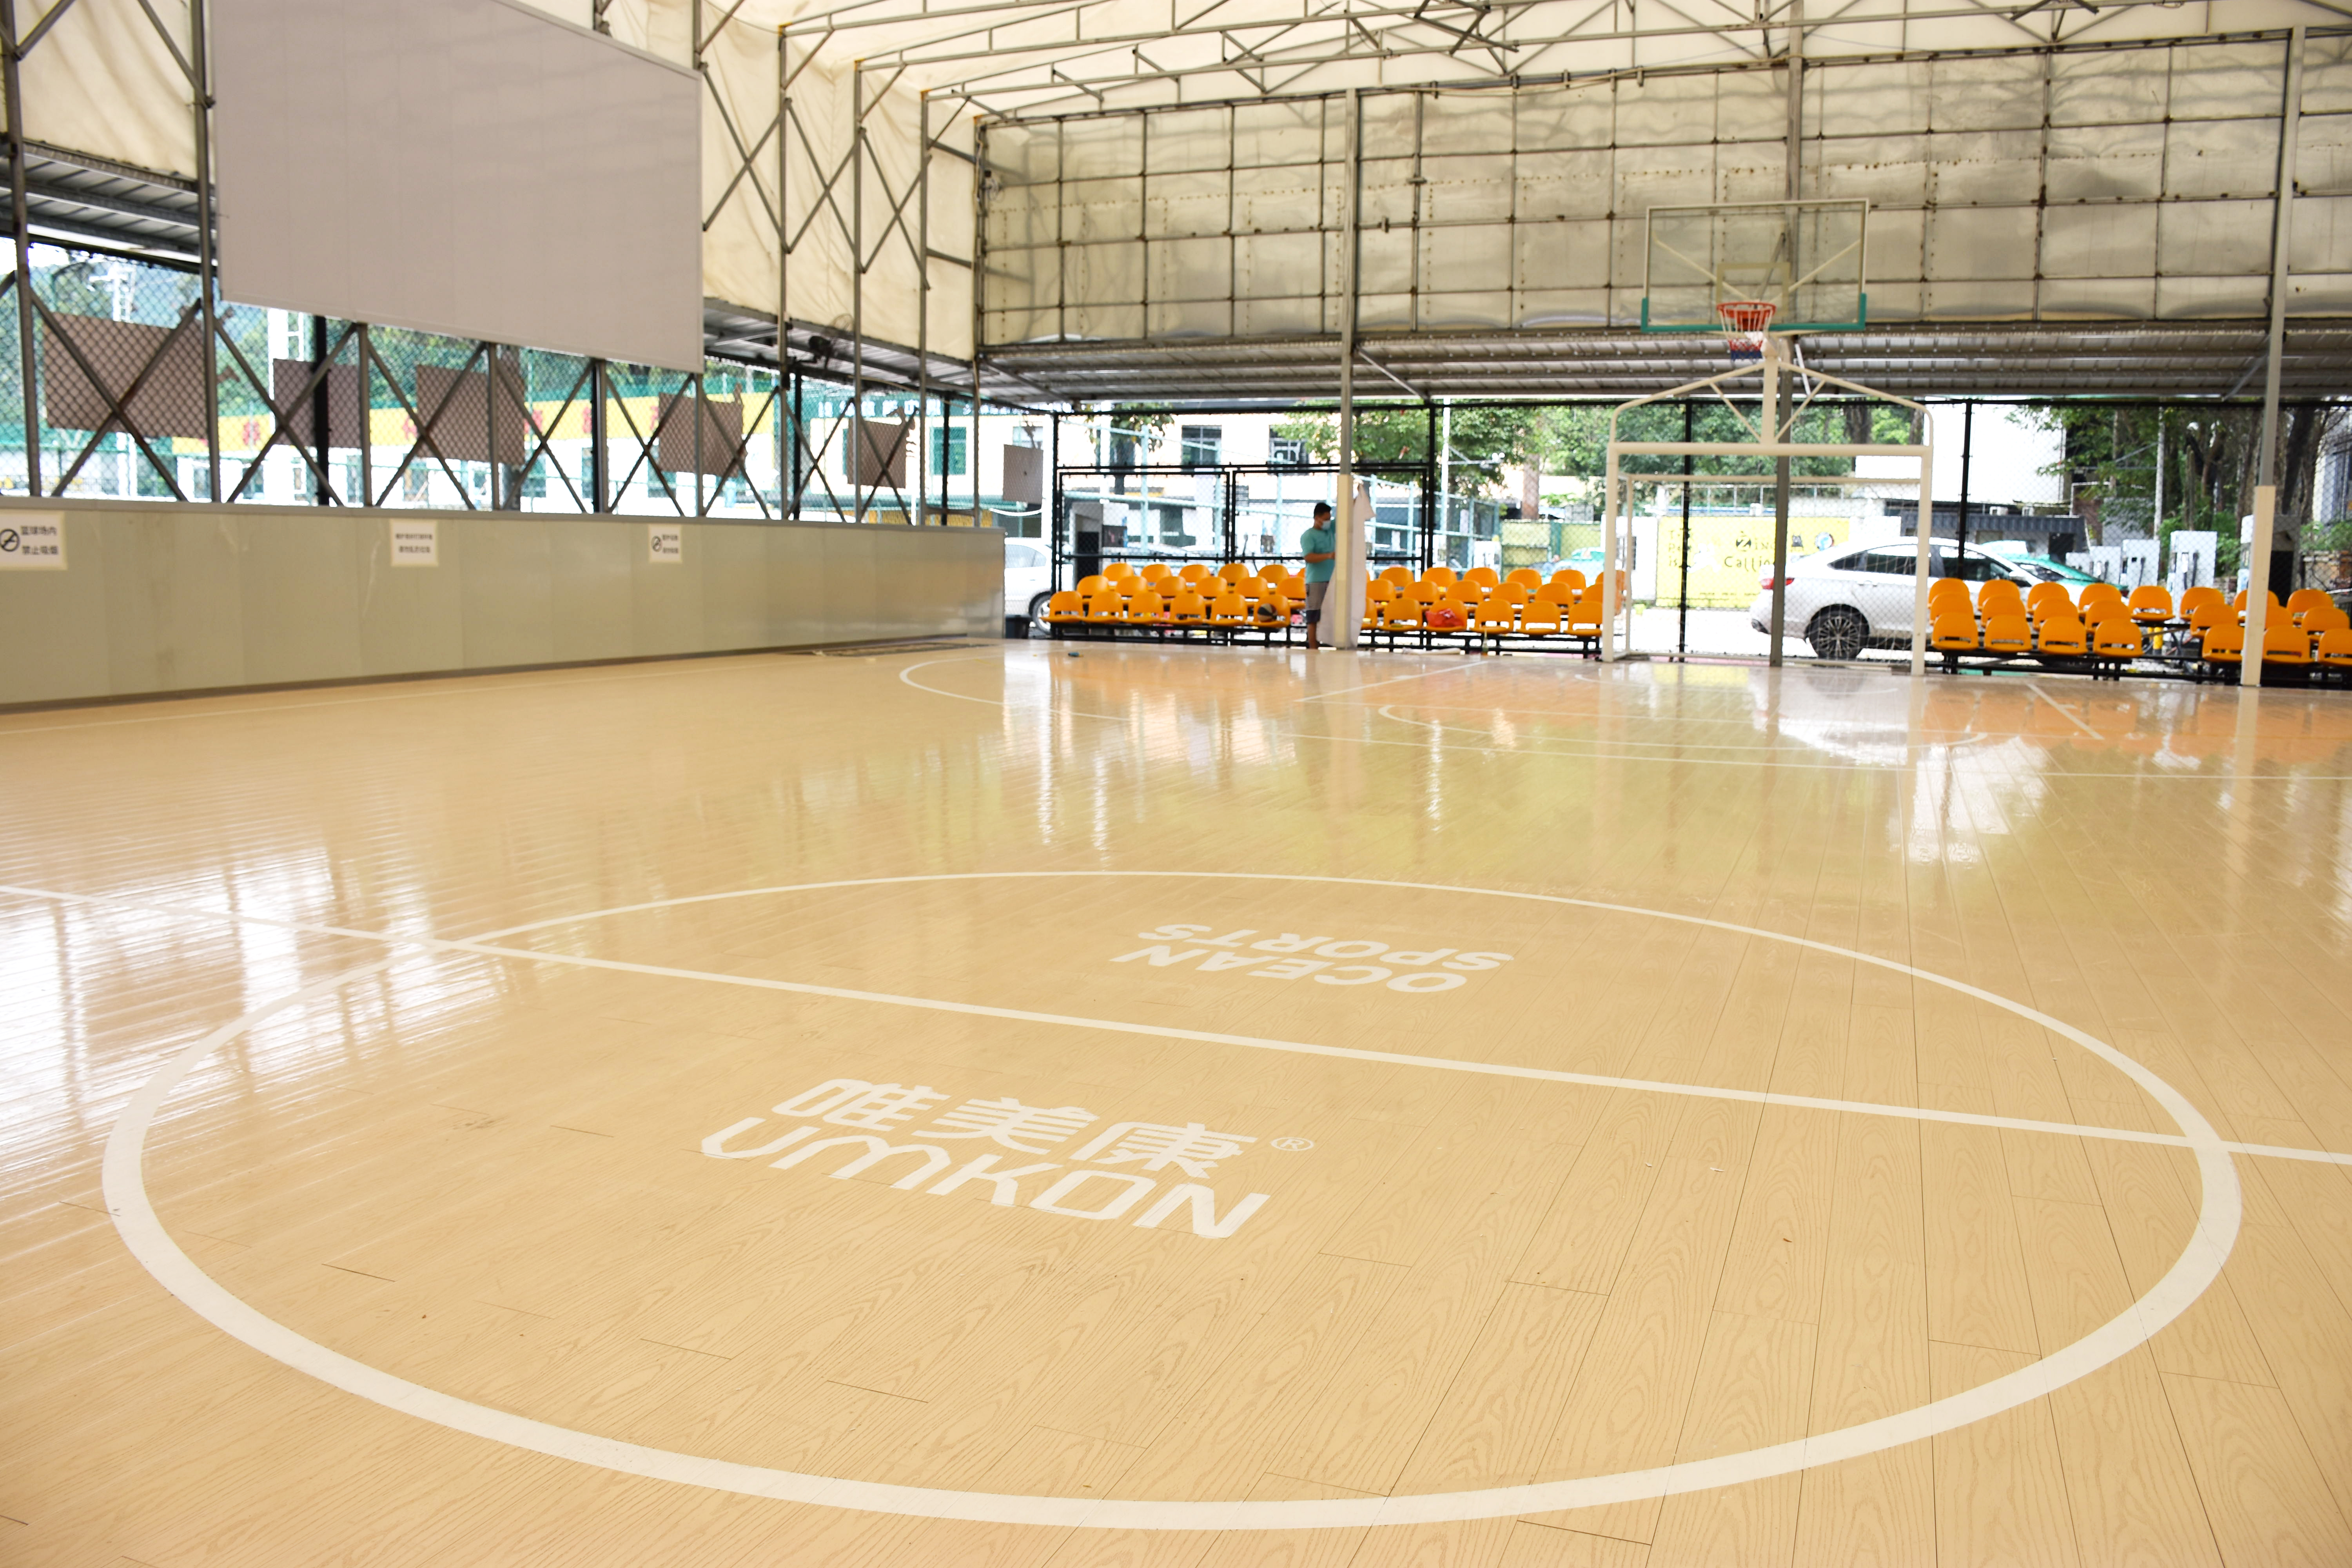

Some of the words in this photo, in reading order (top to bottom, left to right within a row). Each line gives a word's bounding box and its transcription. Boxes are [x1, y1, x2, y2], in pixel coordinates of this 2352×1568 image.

[1109, 945, 1467, 993] OCEAN
[1138, 924, 1514, 970] SPORTS
[771, 1078, 1258, 1179] 唯美康
